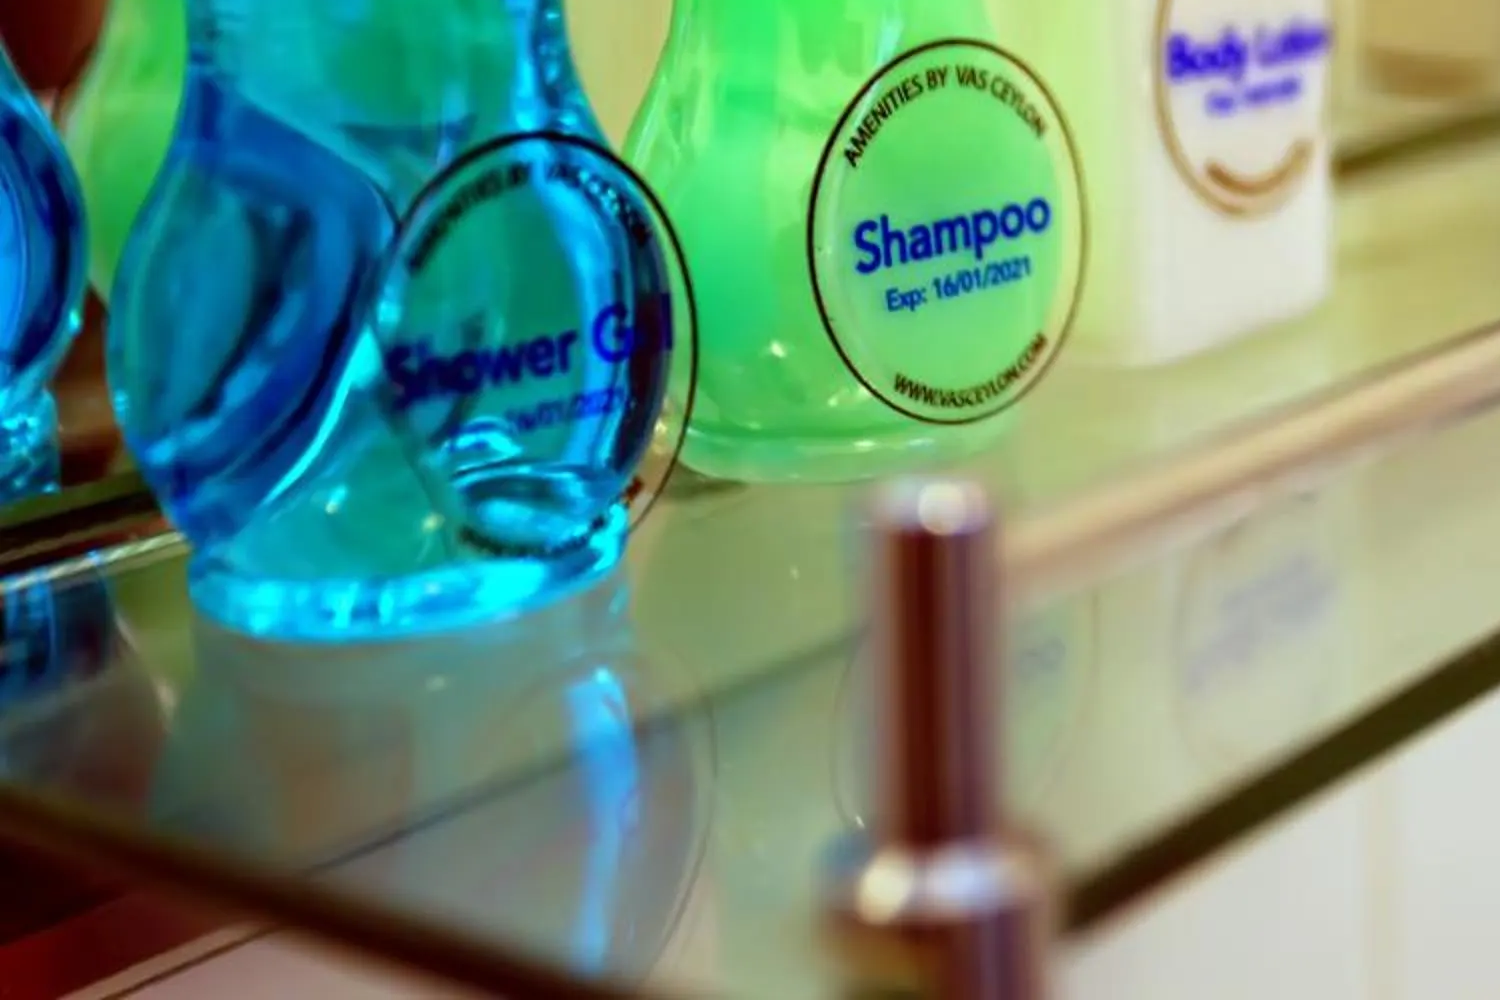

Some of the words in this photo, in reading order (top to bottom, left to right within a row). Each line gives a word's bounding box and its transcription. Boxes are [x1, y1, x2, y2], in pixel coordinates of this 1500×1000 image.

[844, 74, 924, 168] AMENITIES
[925, 66, 949, 90] BY
[955, 65, 988, 91] VAS
[990, 76, 1046, 139] CEYLON
[853, 197, 1052, 275] Shampoo
[886, 287, 928, 312] Exp:
[932, 255, 1031, 299] 16/01/2021
[385, 328, 578, 404] Shower
